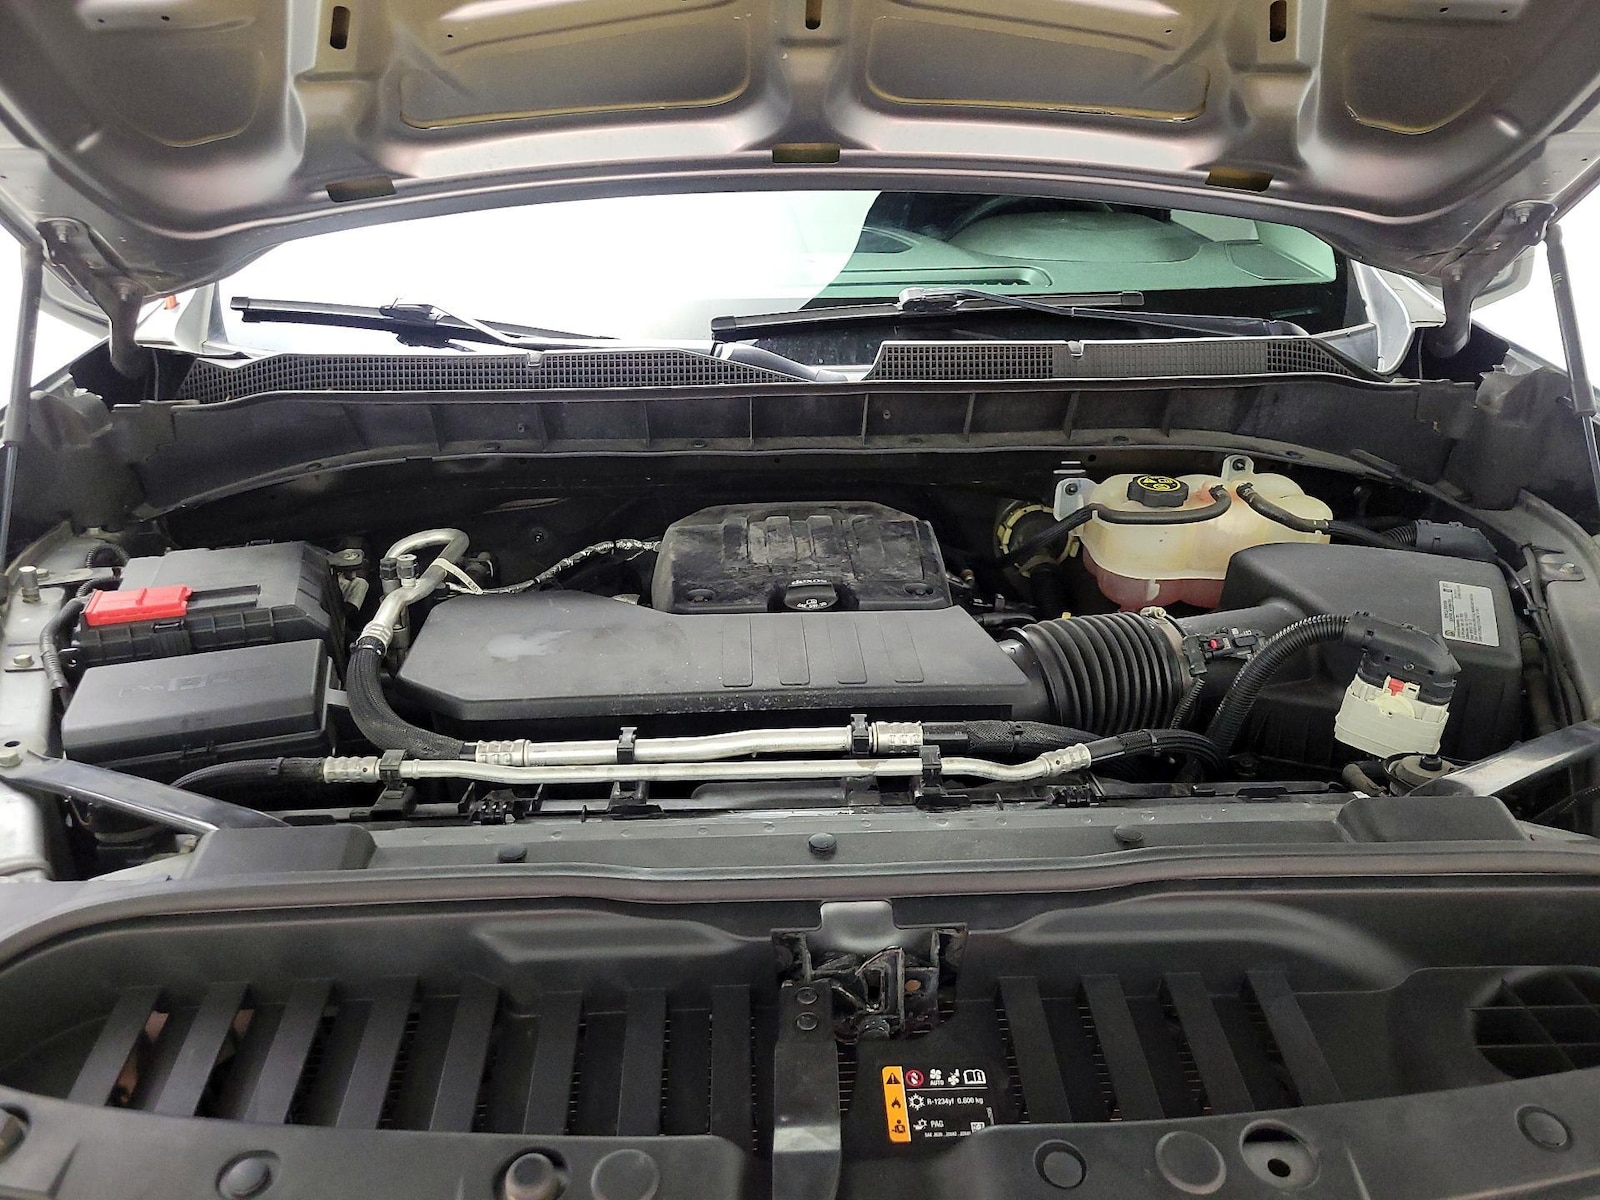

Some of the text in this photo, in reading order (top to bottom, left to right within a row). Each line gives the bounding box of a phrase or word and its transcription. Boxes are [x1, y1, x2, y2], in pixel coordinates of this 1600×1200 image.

[926, 1097, 955, 1106] R-1234yf
[975, 1096, 984, 1105] kg
[930, 1120, 945, 1128] PAG
